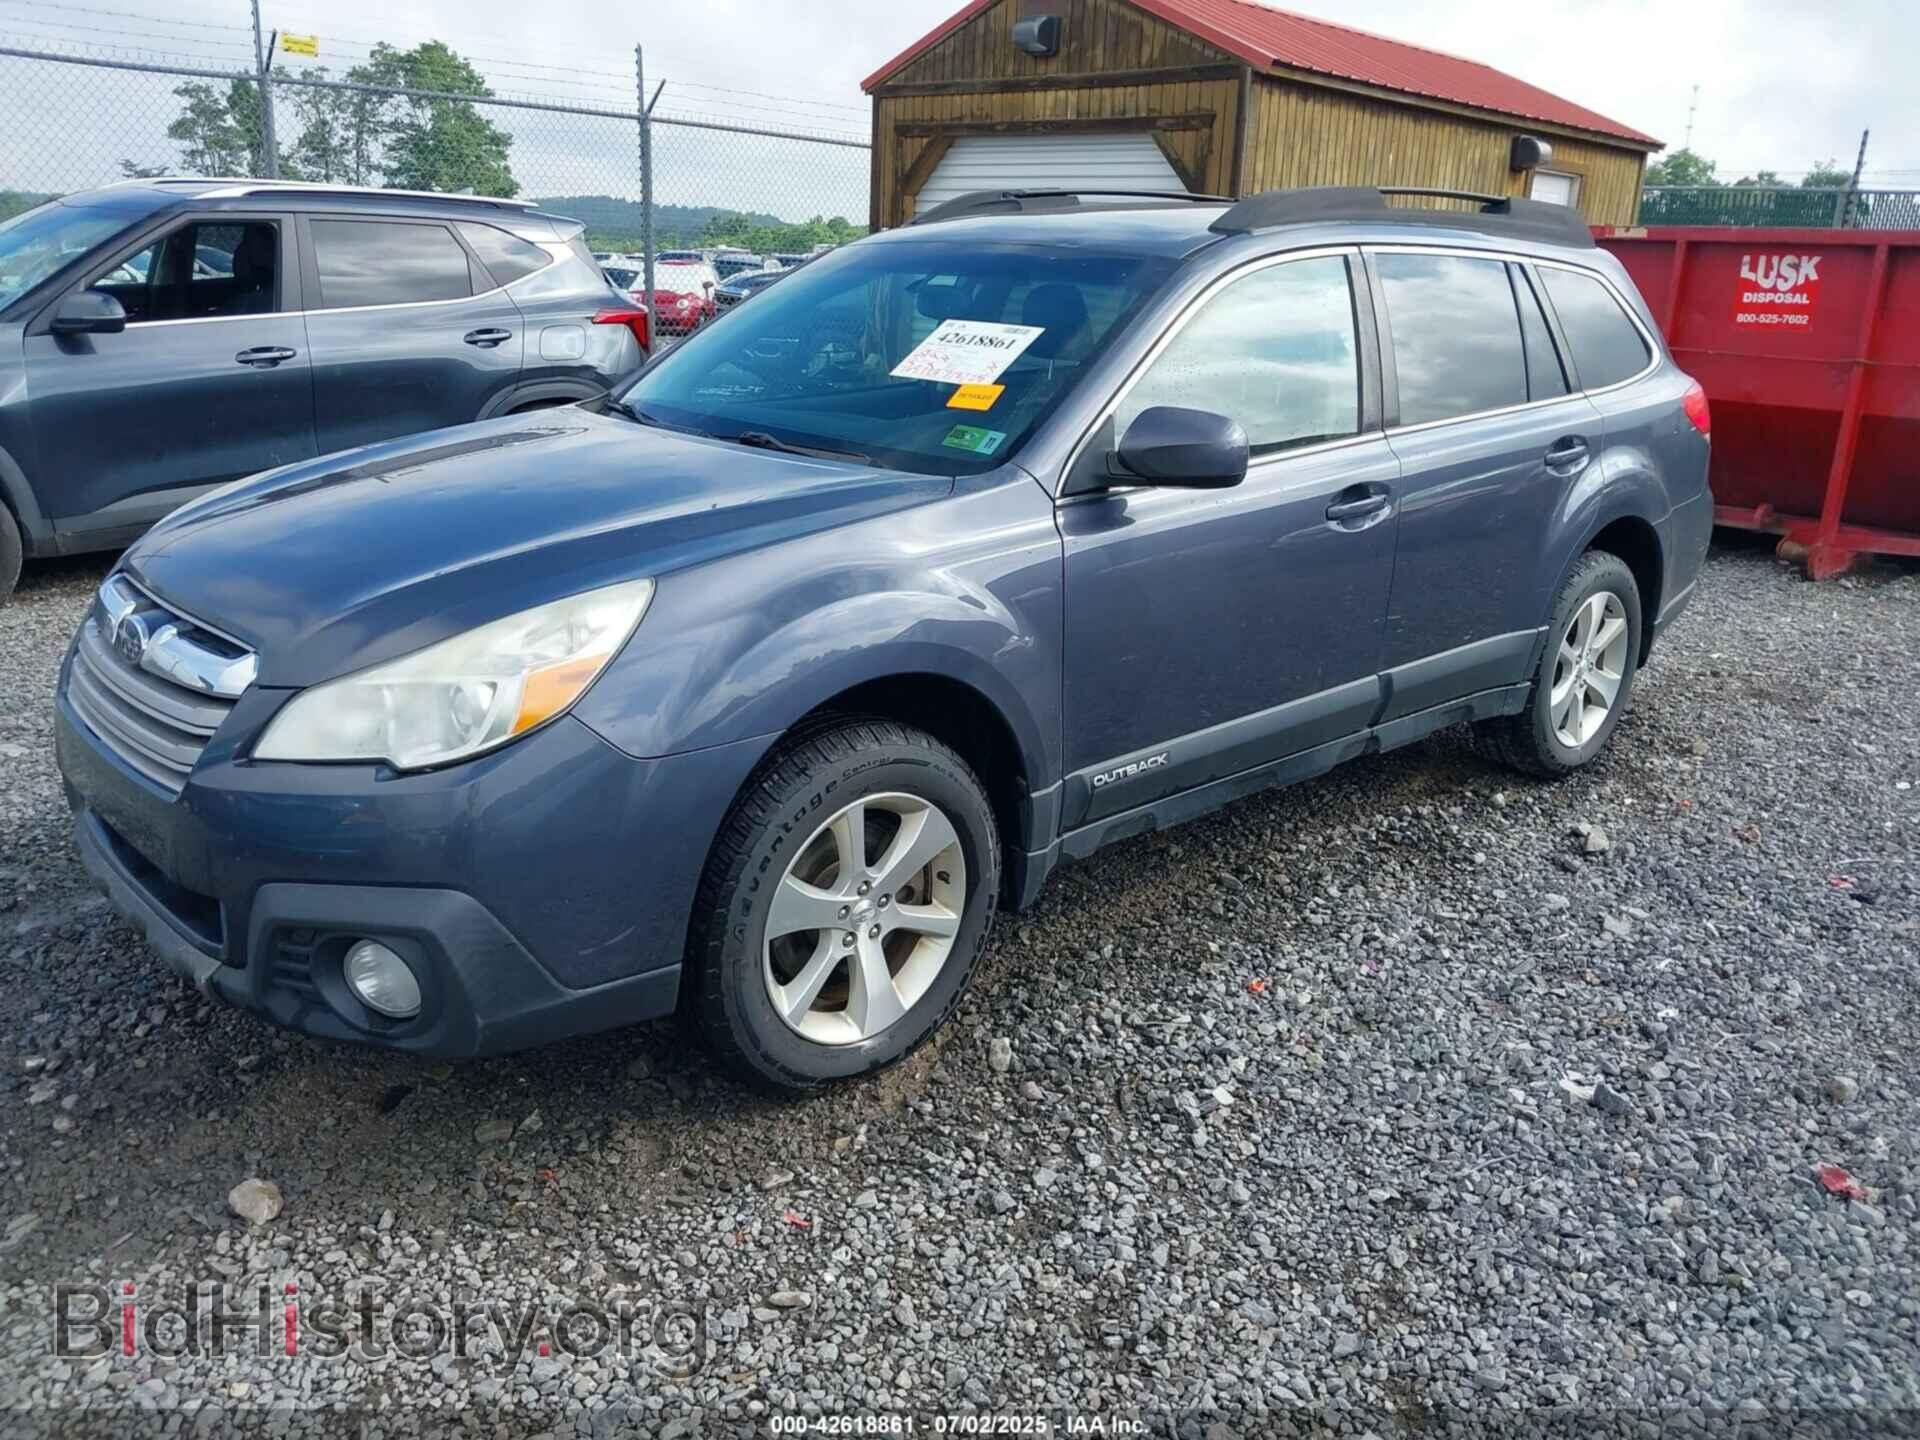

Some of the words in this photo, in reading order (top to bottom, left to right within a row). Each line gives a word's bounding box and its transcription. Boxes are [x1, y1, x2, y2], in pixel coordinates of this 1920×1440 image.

[1740, 254, 1822, 291] LUSK
[1742, 292, 1810, 304] DISPOSAL
[1736, 312, 1809, 325] 800-525-7602
[937, 332, 1016, 350] 42618861
[1093, 753, 1168, 786] OUTBACK
